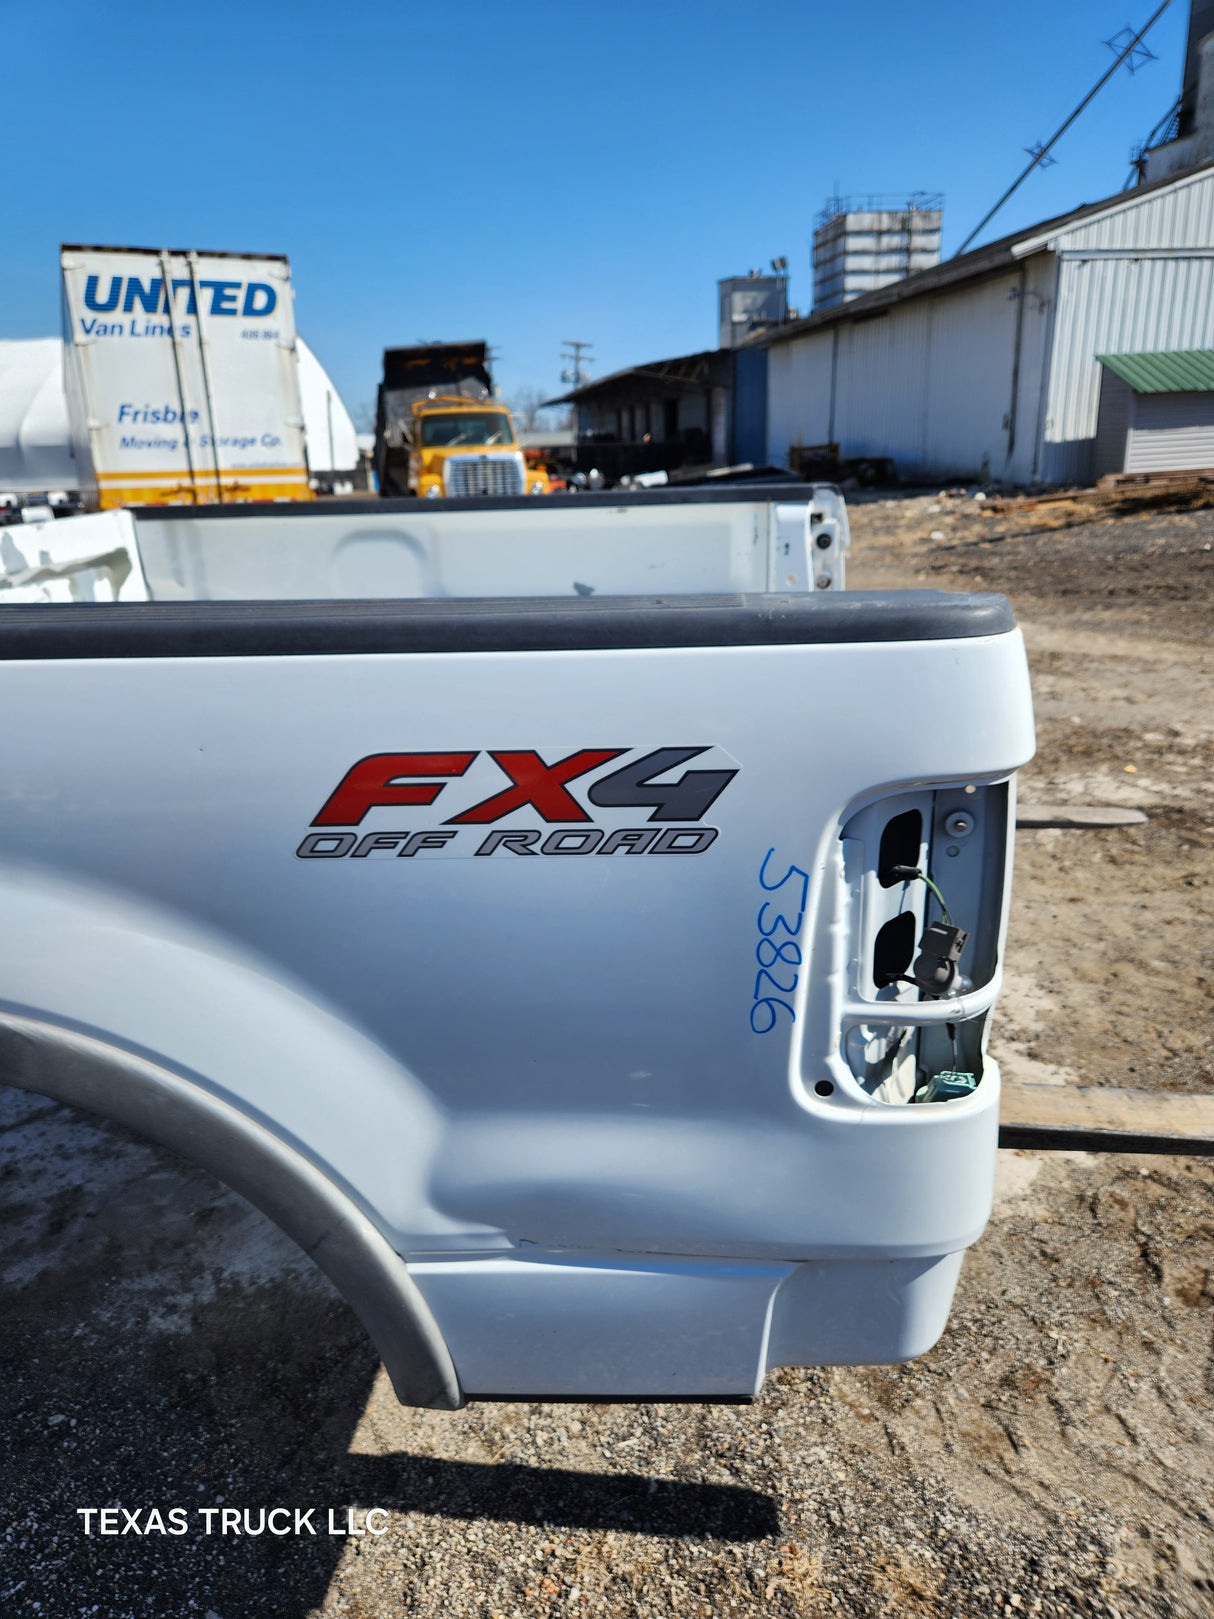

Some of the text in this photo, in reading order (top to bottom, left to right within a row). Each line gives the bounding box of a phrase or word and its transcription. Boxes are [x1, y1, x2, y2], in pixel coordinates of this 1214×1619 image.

[84, 275, 277, 318] UNITED
[80, 318, 123, 337] Van
[200, 434, 257, 450] Srage
[309, 746, 741, 827] FX4
[296, 828, 719, 859] OFF ROAD
[750, 847, 809, 1034] 53826
